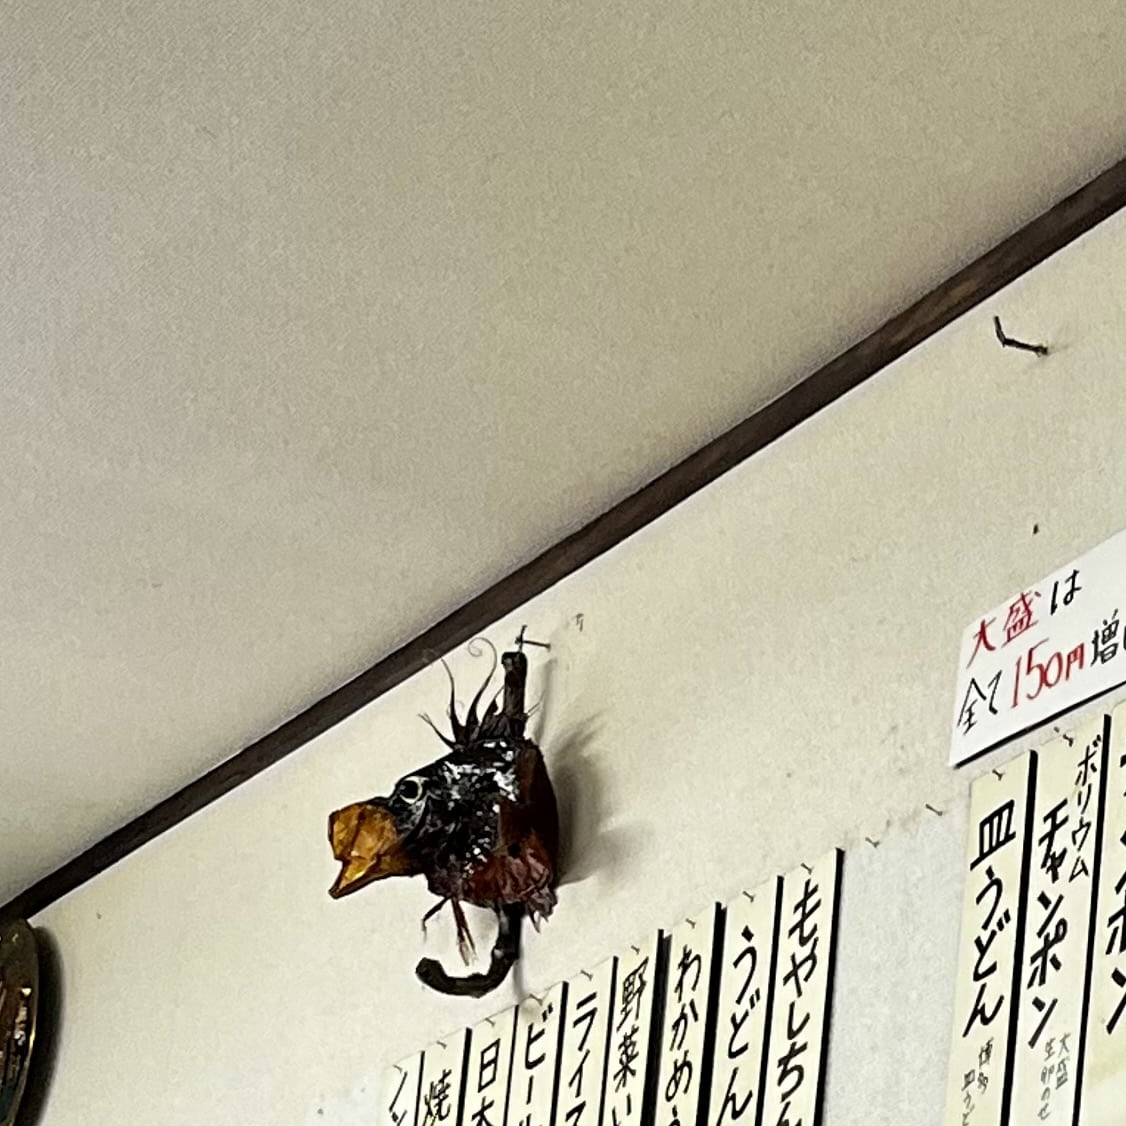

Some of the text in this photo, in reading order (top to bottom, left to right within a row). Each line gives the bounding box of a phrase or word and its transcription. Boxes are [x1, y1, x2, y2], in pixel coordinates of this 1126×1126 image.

[967, 568, 1083, 670] 大盛は
[962, 799, 1016, 1038] 皿うどん
[1026, 798, 1069, 1049] チャンポン
